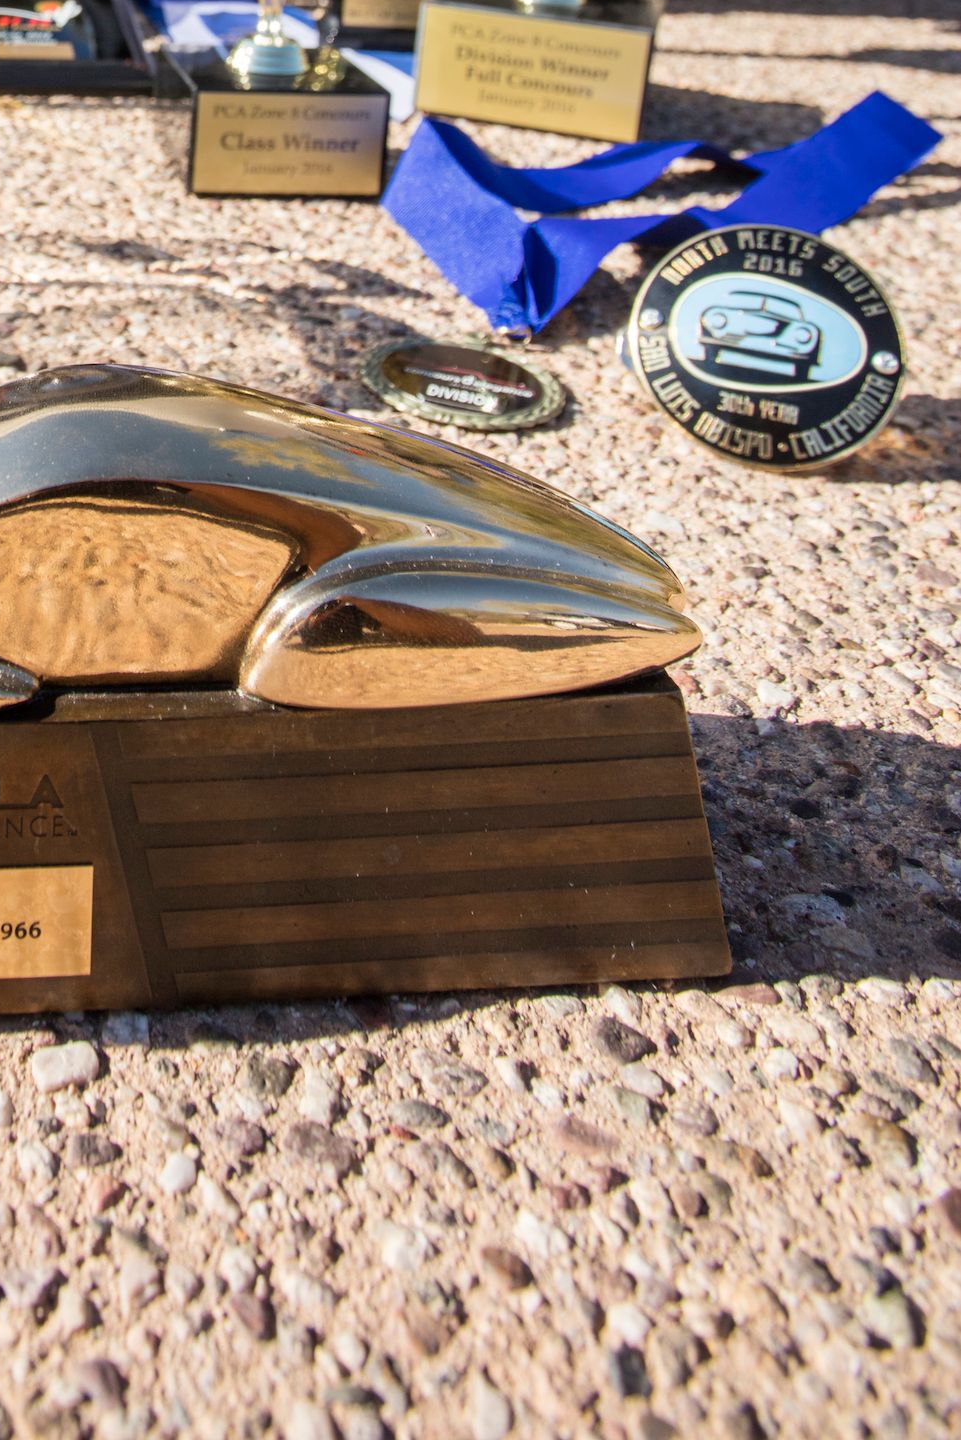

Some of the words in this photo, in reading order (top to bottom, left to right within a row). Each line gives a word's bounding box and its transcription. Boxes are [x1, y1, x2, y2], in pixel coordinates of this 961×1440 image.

[455, 45, 535, 69] Division
[541, 56, 611, 81] Winner
[464, 64, 502, 84] Full
[506, 72, 594, 98] Concours
[219, 131, 276, 152] Class
[283, 132, 361, 154] Winner
[660, 235, 730, 286] NORTH
[737, 229, 819, 260] MEETS
[821, 255, 888, 317] SOUTH
[743, 252, 803, 278] 2016
[640, 334, 671, 374] SAN
[425, 383, 499, 413] DIVISION
[651, 372, 702, 424] LUIS
[759, 399, 800, 426] YEAR
[788, 374, 896, 460] CALIFORNIA
[693, 411, 775, 460] OBISPO
